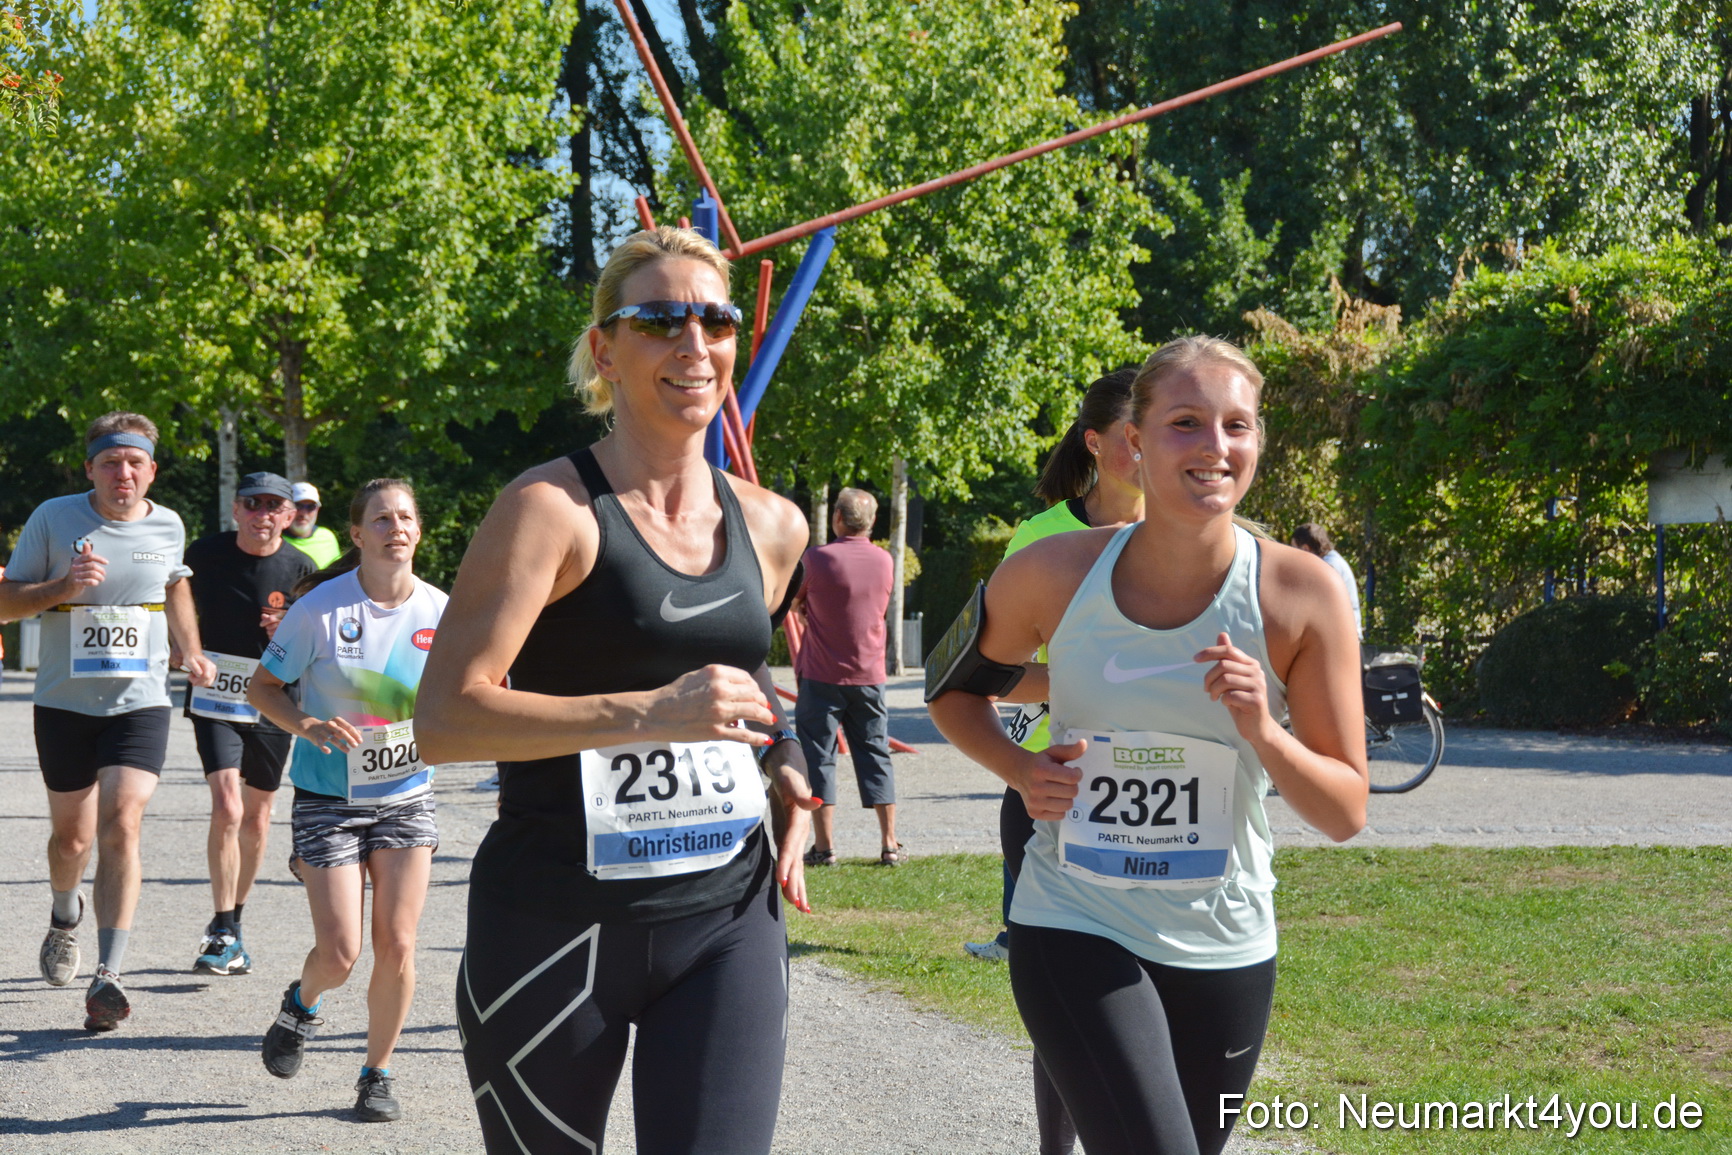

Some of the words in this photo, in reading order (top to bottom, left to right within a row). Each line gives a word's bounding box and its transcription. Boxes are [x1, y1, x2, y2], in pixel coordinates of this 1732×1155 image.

[83, 626, 138, 648] 2026
[337, 645, 364, 655] PARTL
[100, 660, 121, 670] Max
[214, 703, 236, 713] Hans
[374, 726, 410, 742] BOCK
[362, 740, 420, 773] 3020
[1113, 747, 1185, 764] BOCK
[610, 746, 736, 805] 2319
[595, 797, 603, 807] D
[1088, 775, 1199, 827] 2321
[628, 810, 666, 823] PARTL
[668, 805, 718, 819] Neumarkt
[1072, 809, 1079, 820] D
[628, 830, 733, 858] Christiane
[1097, 832, 1134, 844] PARTL
[1136, 834, 1184, 845] Neumarkt
[1123, 856, 1170, 876] Nina
